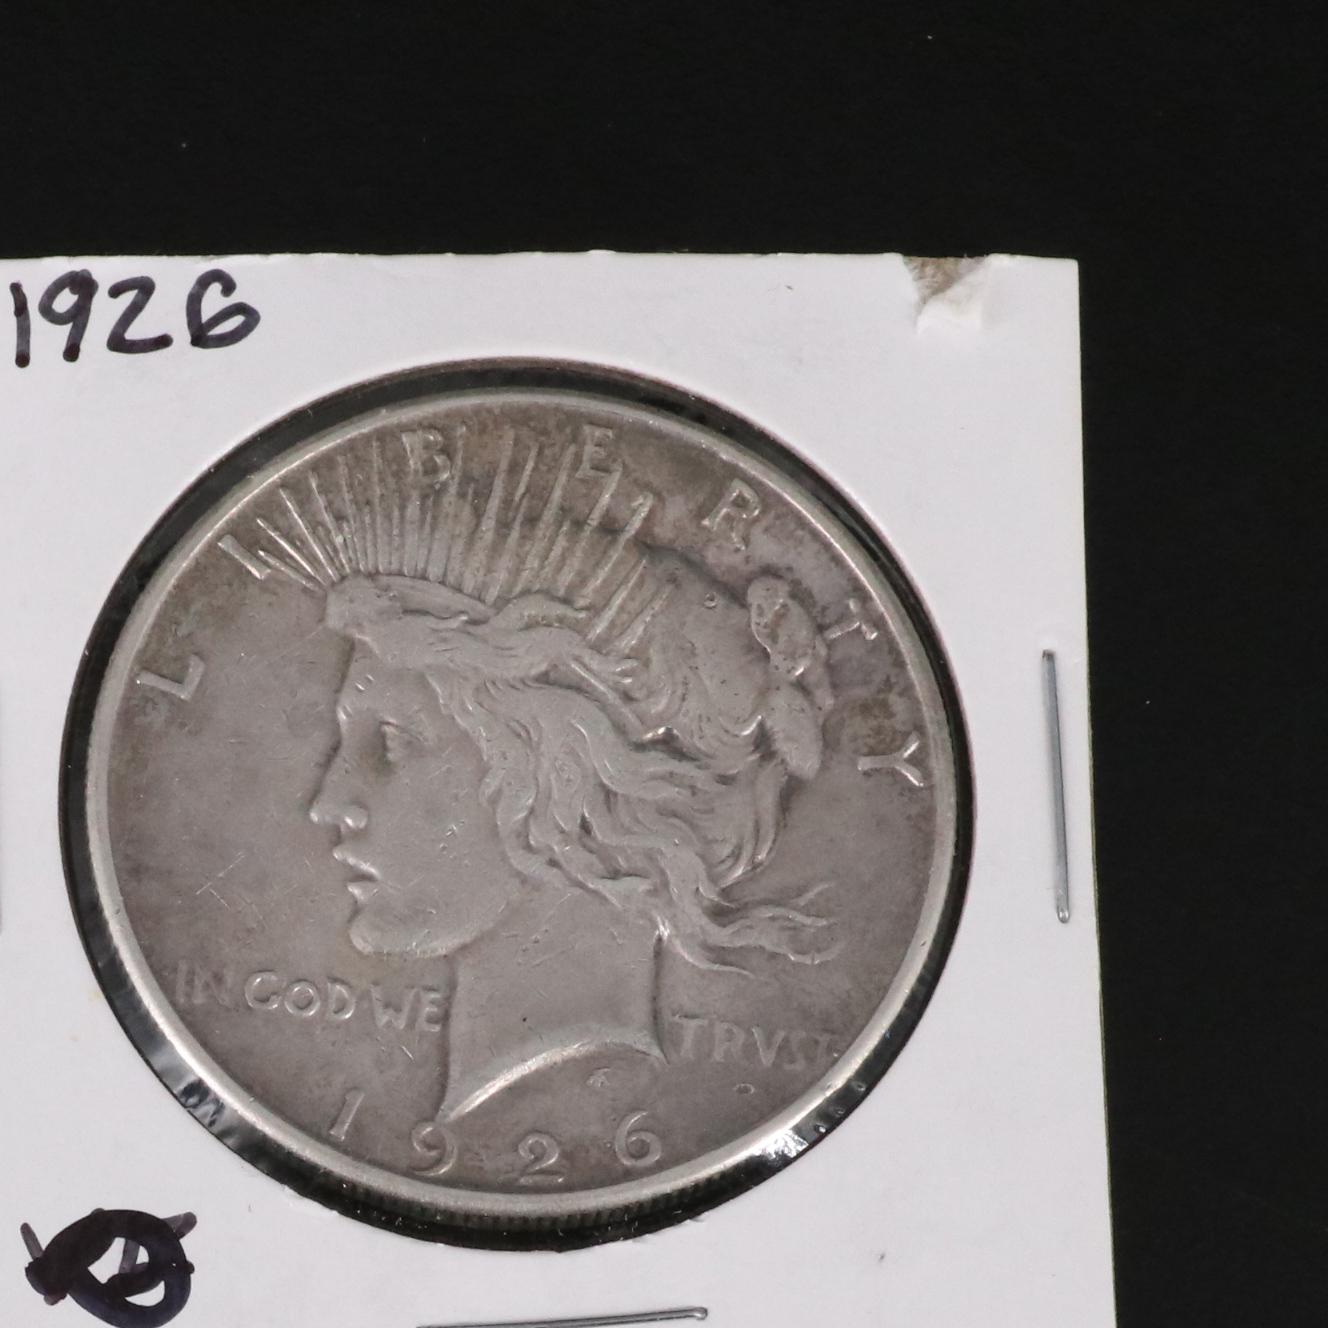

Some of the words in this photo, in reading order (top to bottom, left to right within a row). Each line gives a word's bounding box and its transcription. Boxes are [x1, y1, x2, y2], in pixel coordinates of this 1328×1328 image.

[10, 269, 261, 368] 1926
[244, 970, 358, 1021] GOD
[372, 984, 451, 1033] WE
[328, 1089, 662, 1187] 1926
